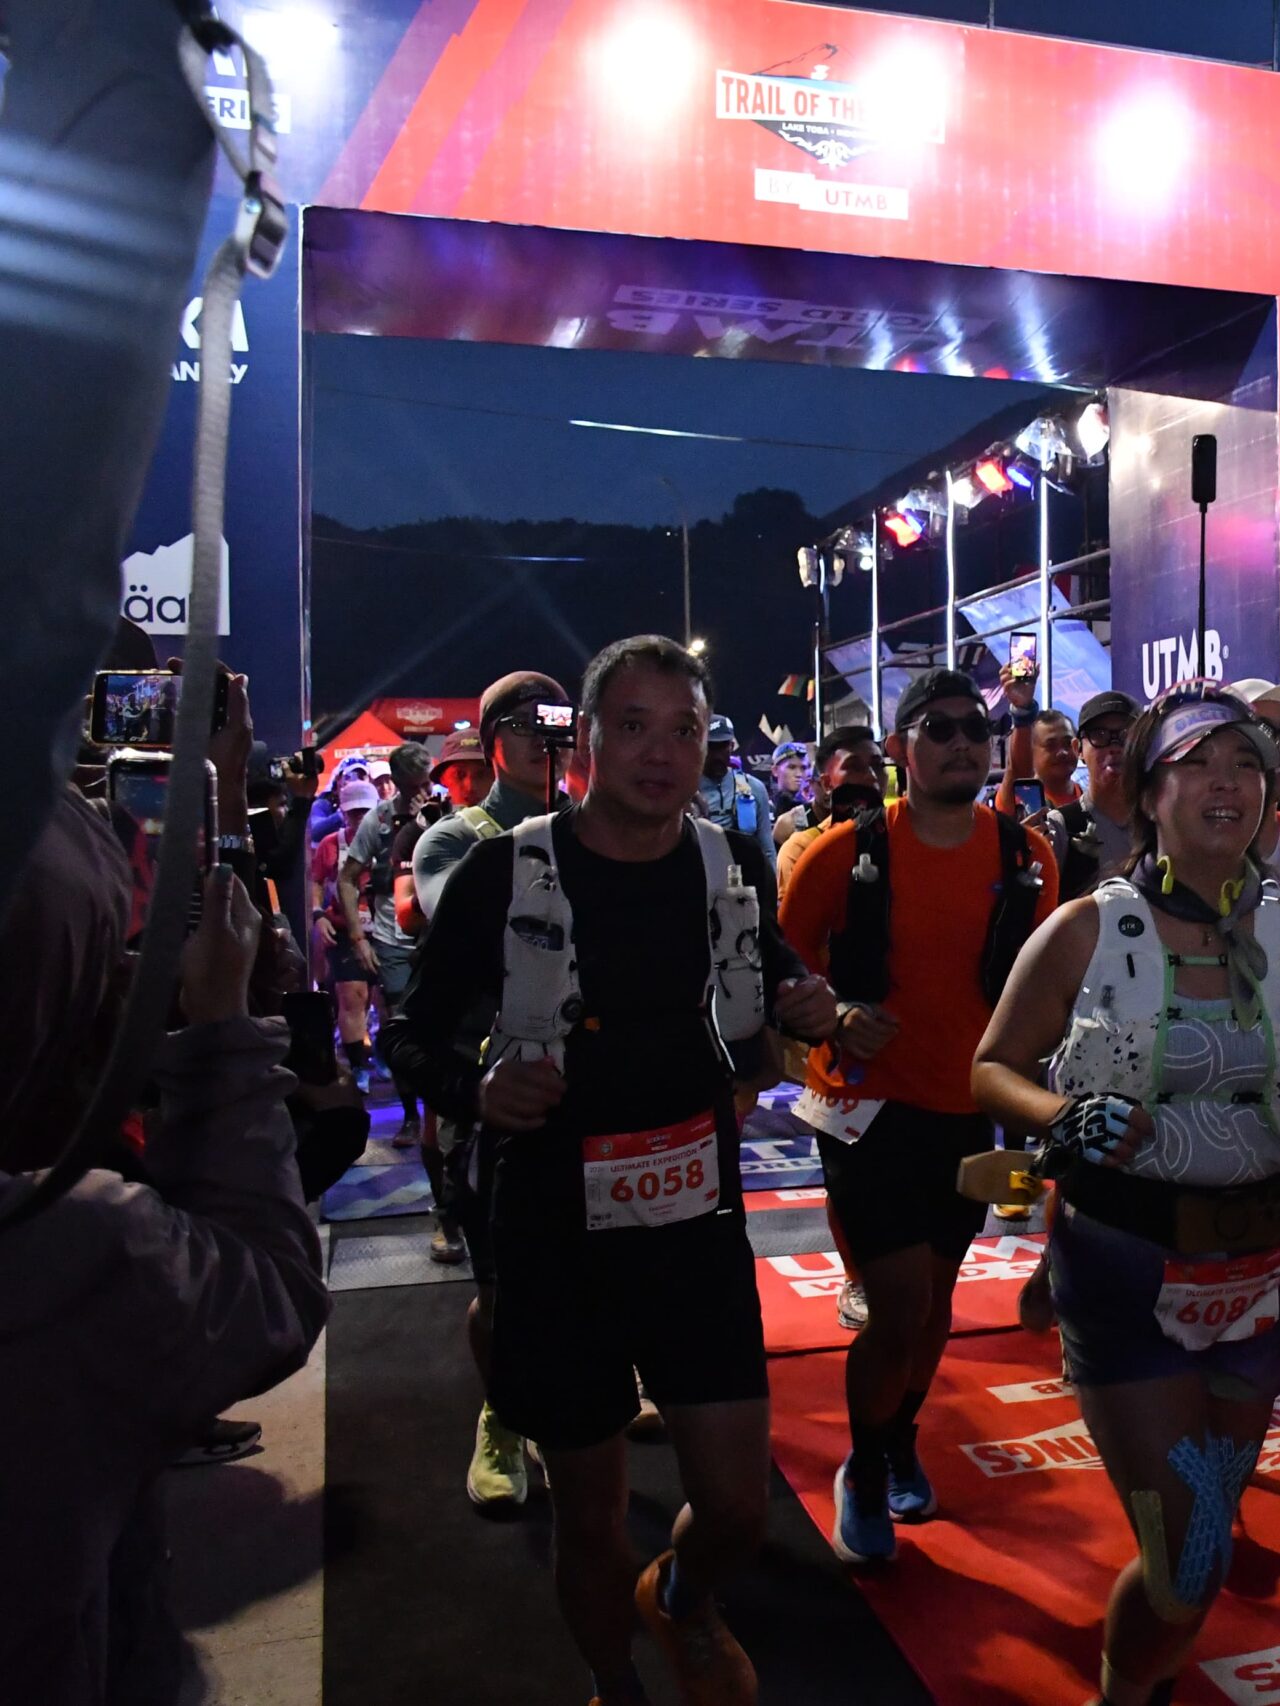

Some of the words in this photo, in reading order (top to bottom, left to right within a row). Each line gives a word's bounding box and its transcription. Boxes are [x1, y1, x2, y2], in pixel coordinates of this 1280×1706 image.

[720, 76, 786, 116] TRAIL
[794, 89, 820, 117] OF
[825, 188, 889, 211] UTMB
[1142, 628, 1224, 700] UTMB
[610, 1160, 650, 1173] ULTIMATE
[653, 1148, 698, 1167] EXPEDITION
[610, 1159, 705, 1203] 6058
[973, 1435, 1101, 1473] INGS
